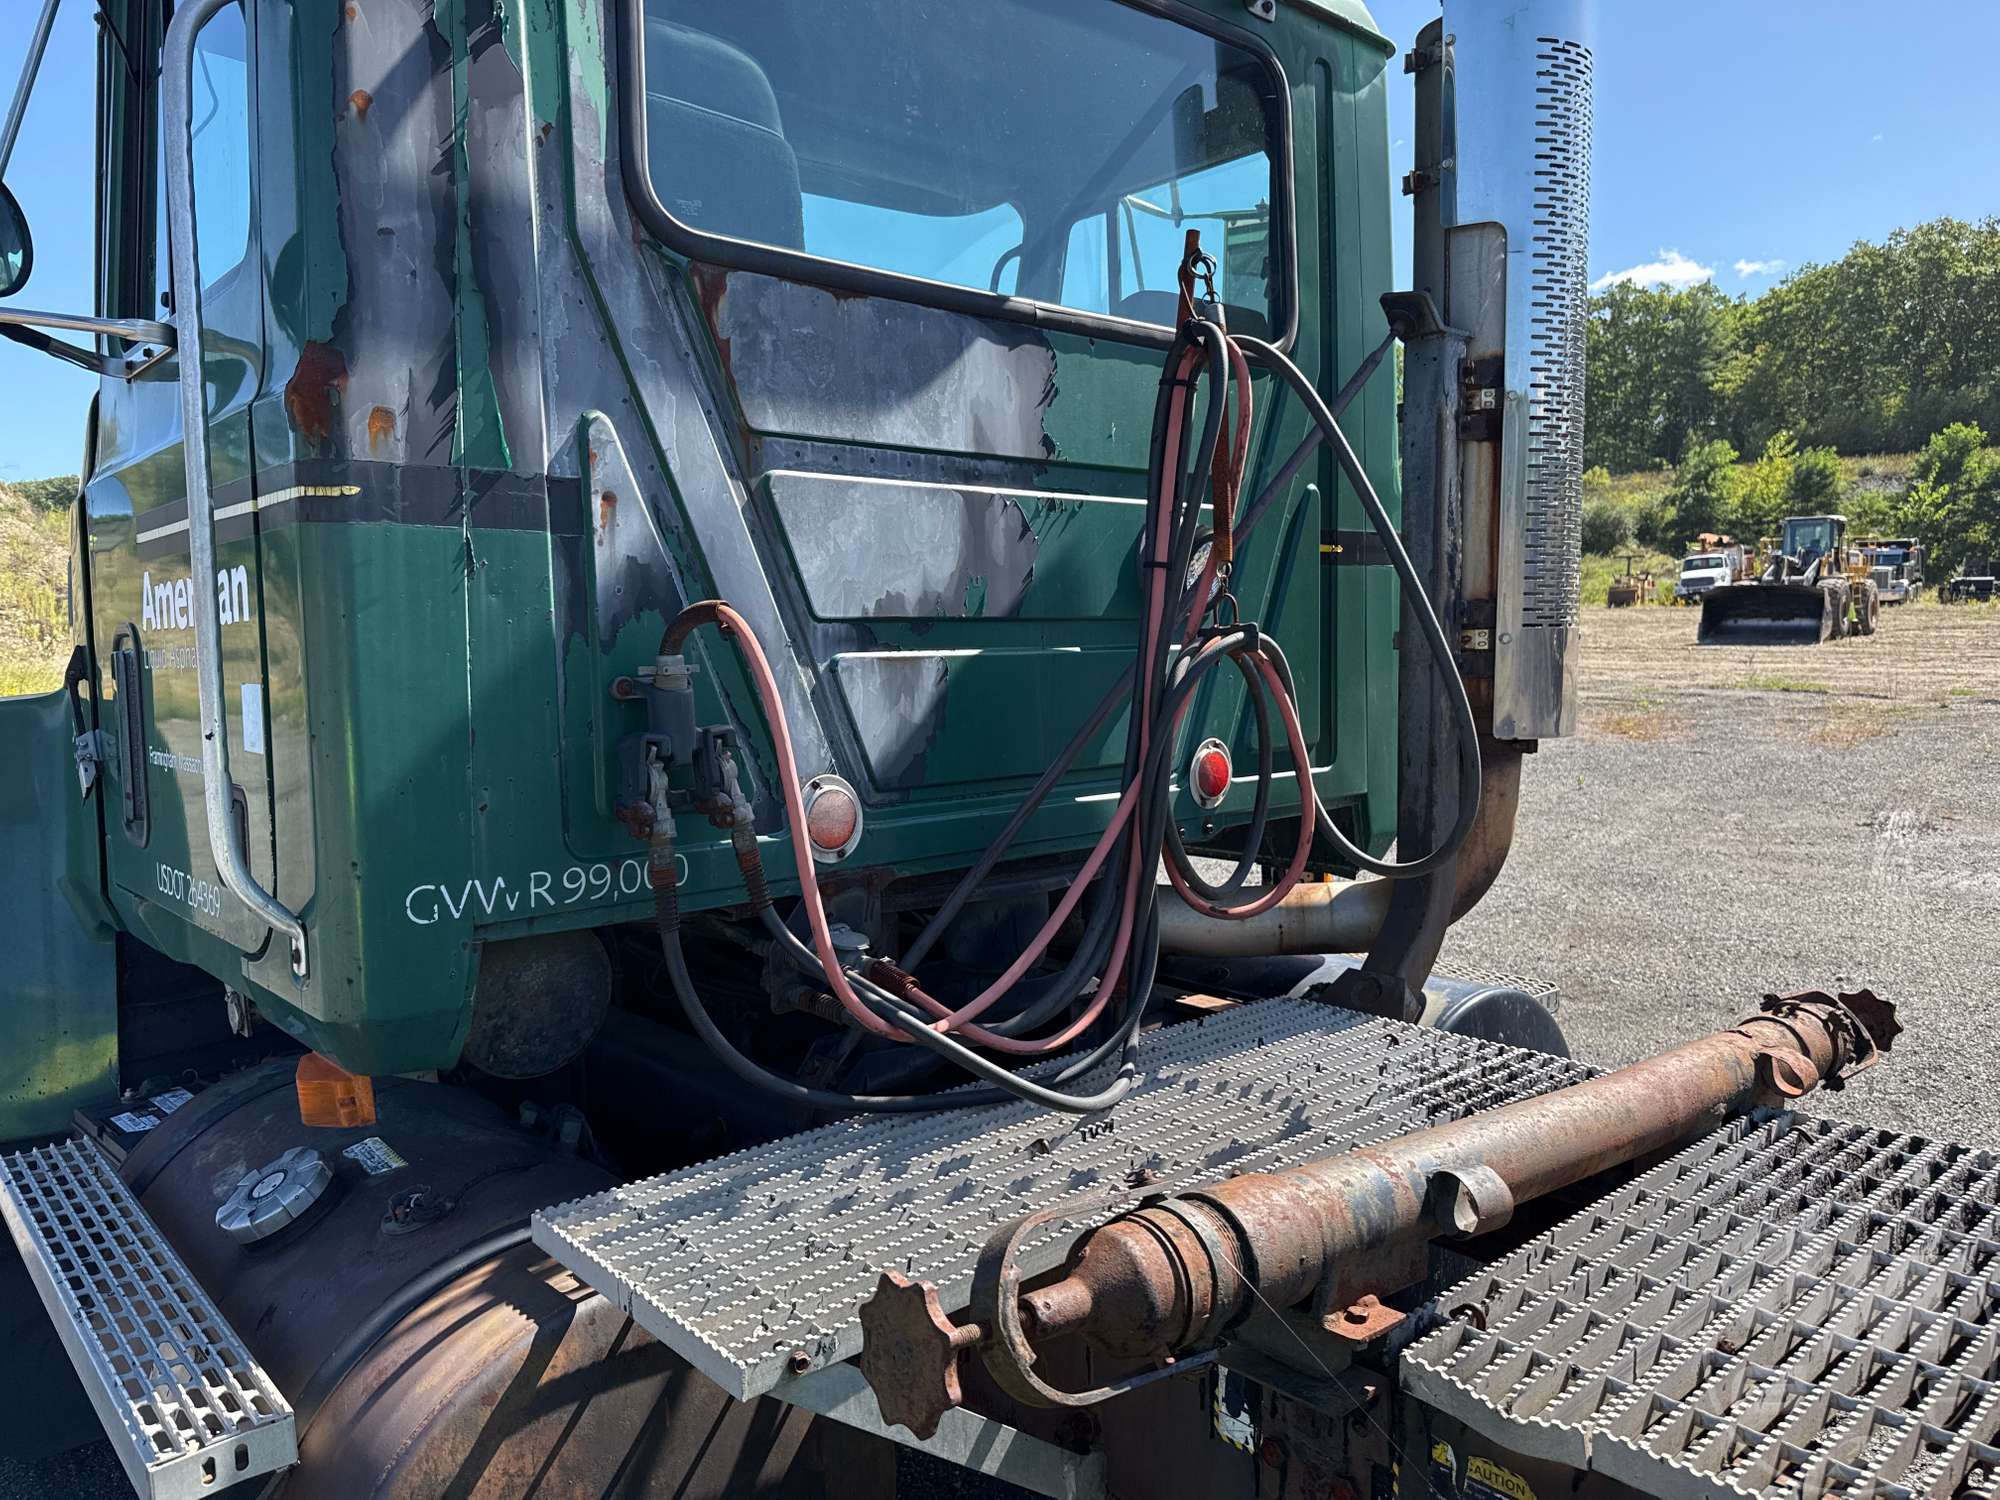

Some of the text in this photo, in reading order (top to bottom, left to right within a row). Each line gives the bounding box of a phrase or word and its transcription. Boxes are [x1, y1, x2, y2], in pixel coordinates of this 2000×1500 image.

[143, 565, 249, 631] Ameran
[156, 861, 221, 918] USDOT 264369
[1469, 1463, 1526, 1497] AUTION
